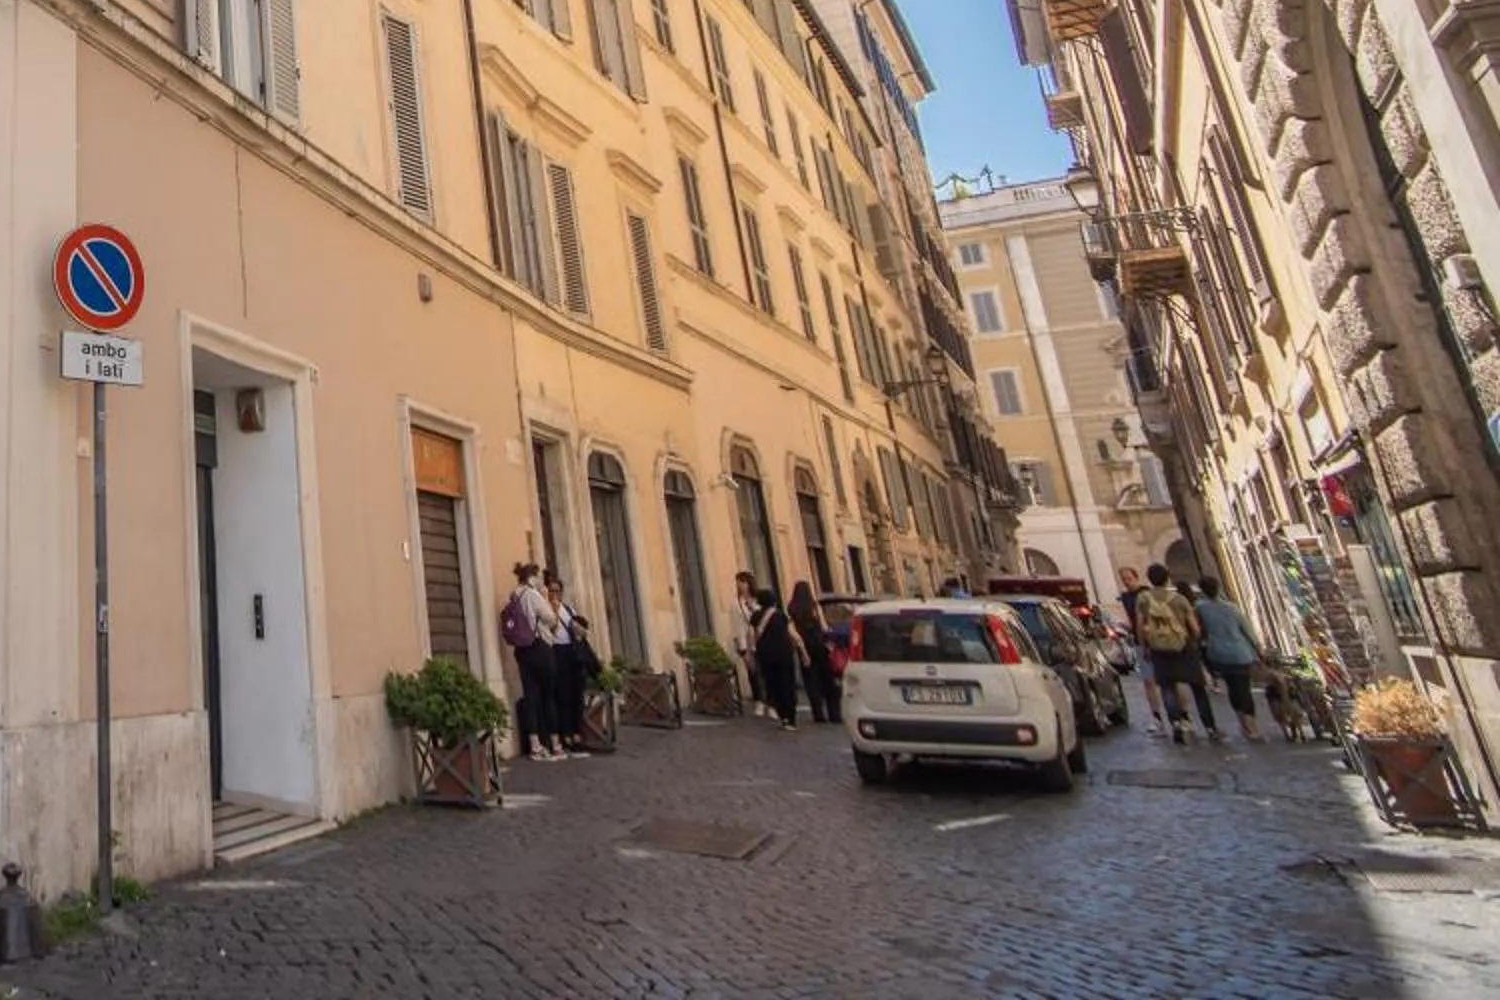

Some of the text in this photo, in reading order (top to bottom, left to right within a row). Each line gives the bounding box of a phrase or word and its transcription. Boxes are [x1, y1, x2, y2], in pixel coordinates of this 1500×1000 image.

[81, 342, 127, 359] ambo
[85, 360, 123, 379] i lati
